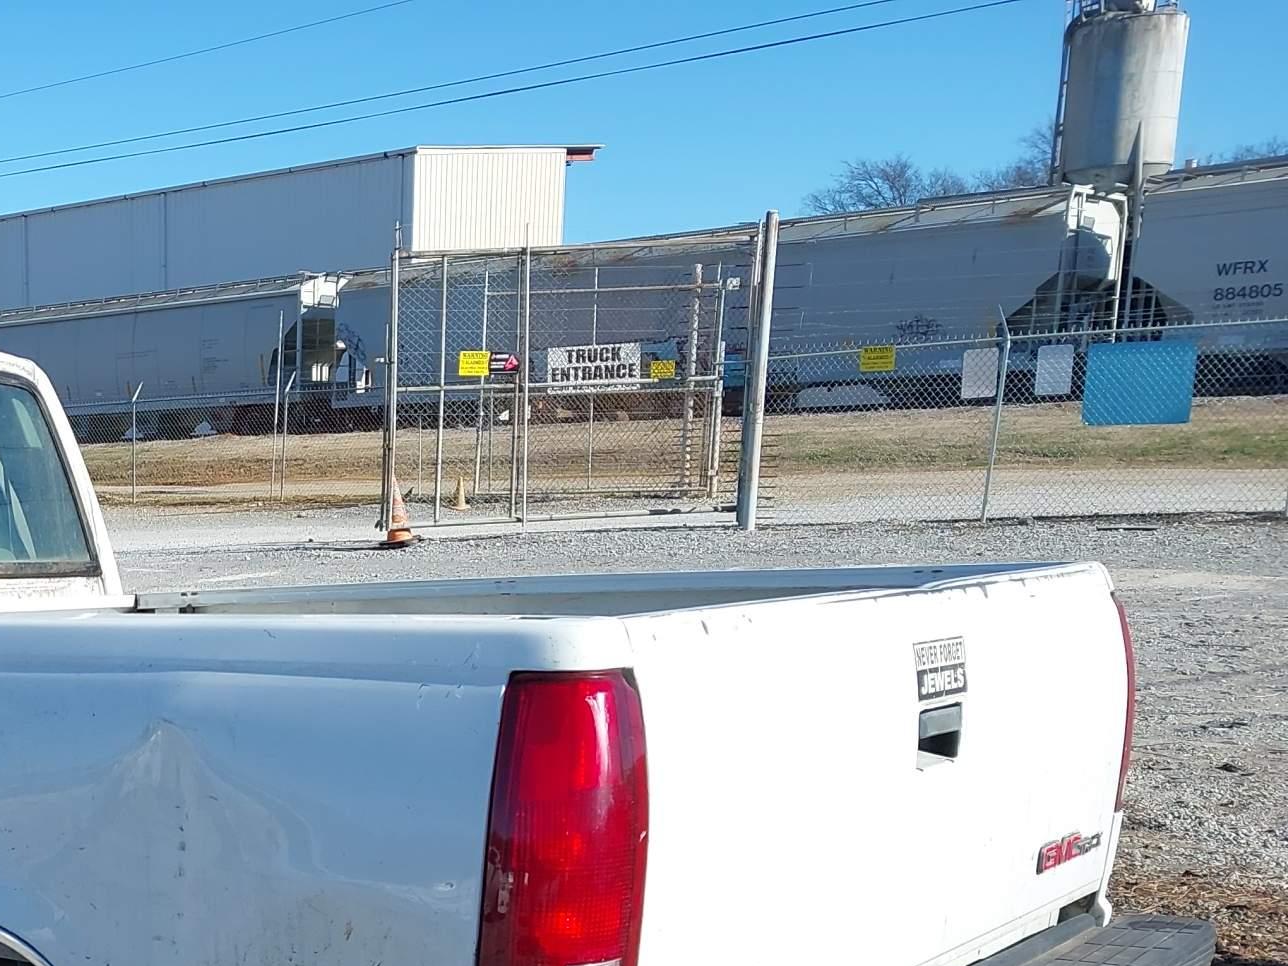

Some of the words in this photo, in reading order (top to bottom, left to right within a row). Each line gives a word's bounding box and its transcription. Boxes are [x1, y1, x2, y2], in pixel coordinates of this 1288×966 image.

[1216, 259, 1269, 277] WFRX
[1213, 282, 1284, 301] 884805
[566, 346, 622, 363] TRUCK
[551, 363, 638, 382] ENTRANCE
[915, 645, 939, 668] NEVER
[939, 640, 963, 664] FORGET
[920, 666, 965, 696] JEWELS
[1036, 831, 1082, 875] GMC
